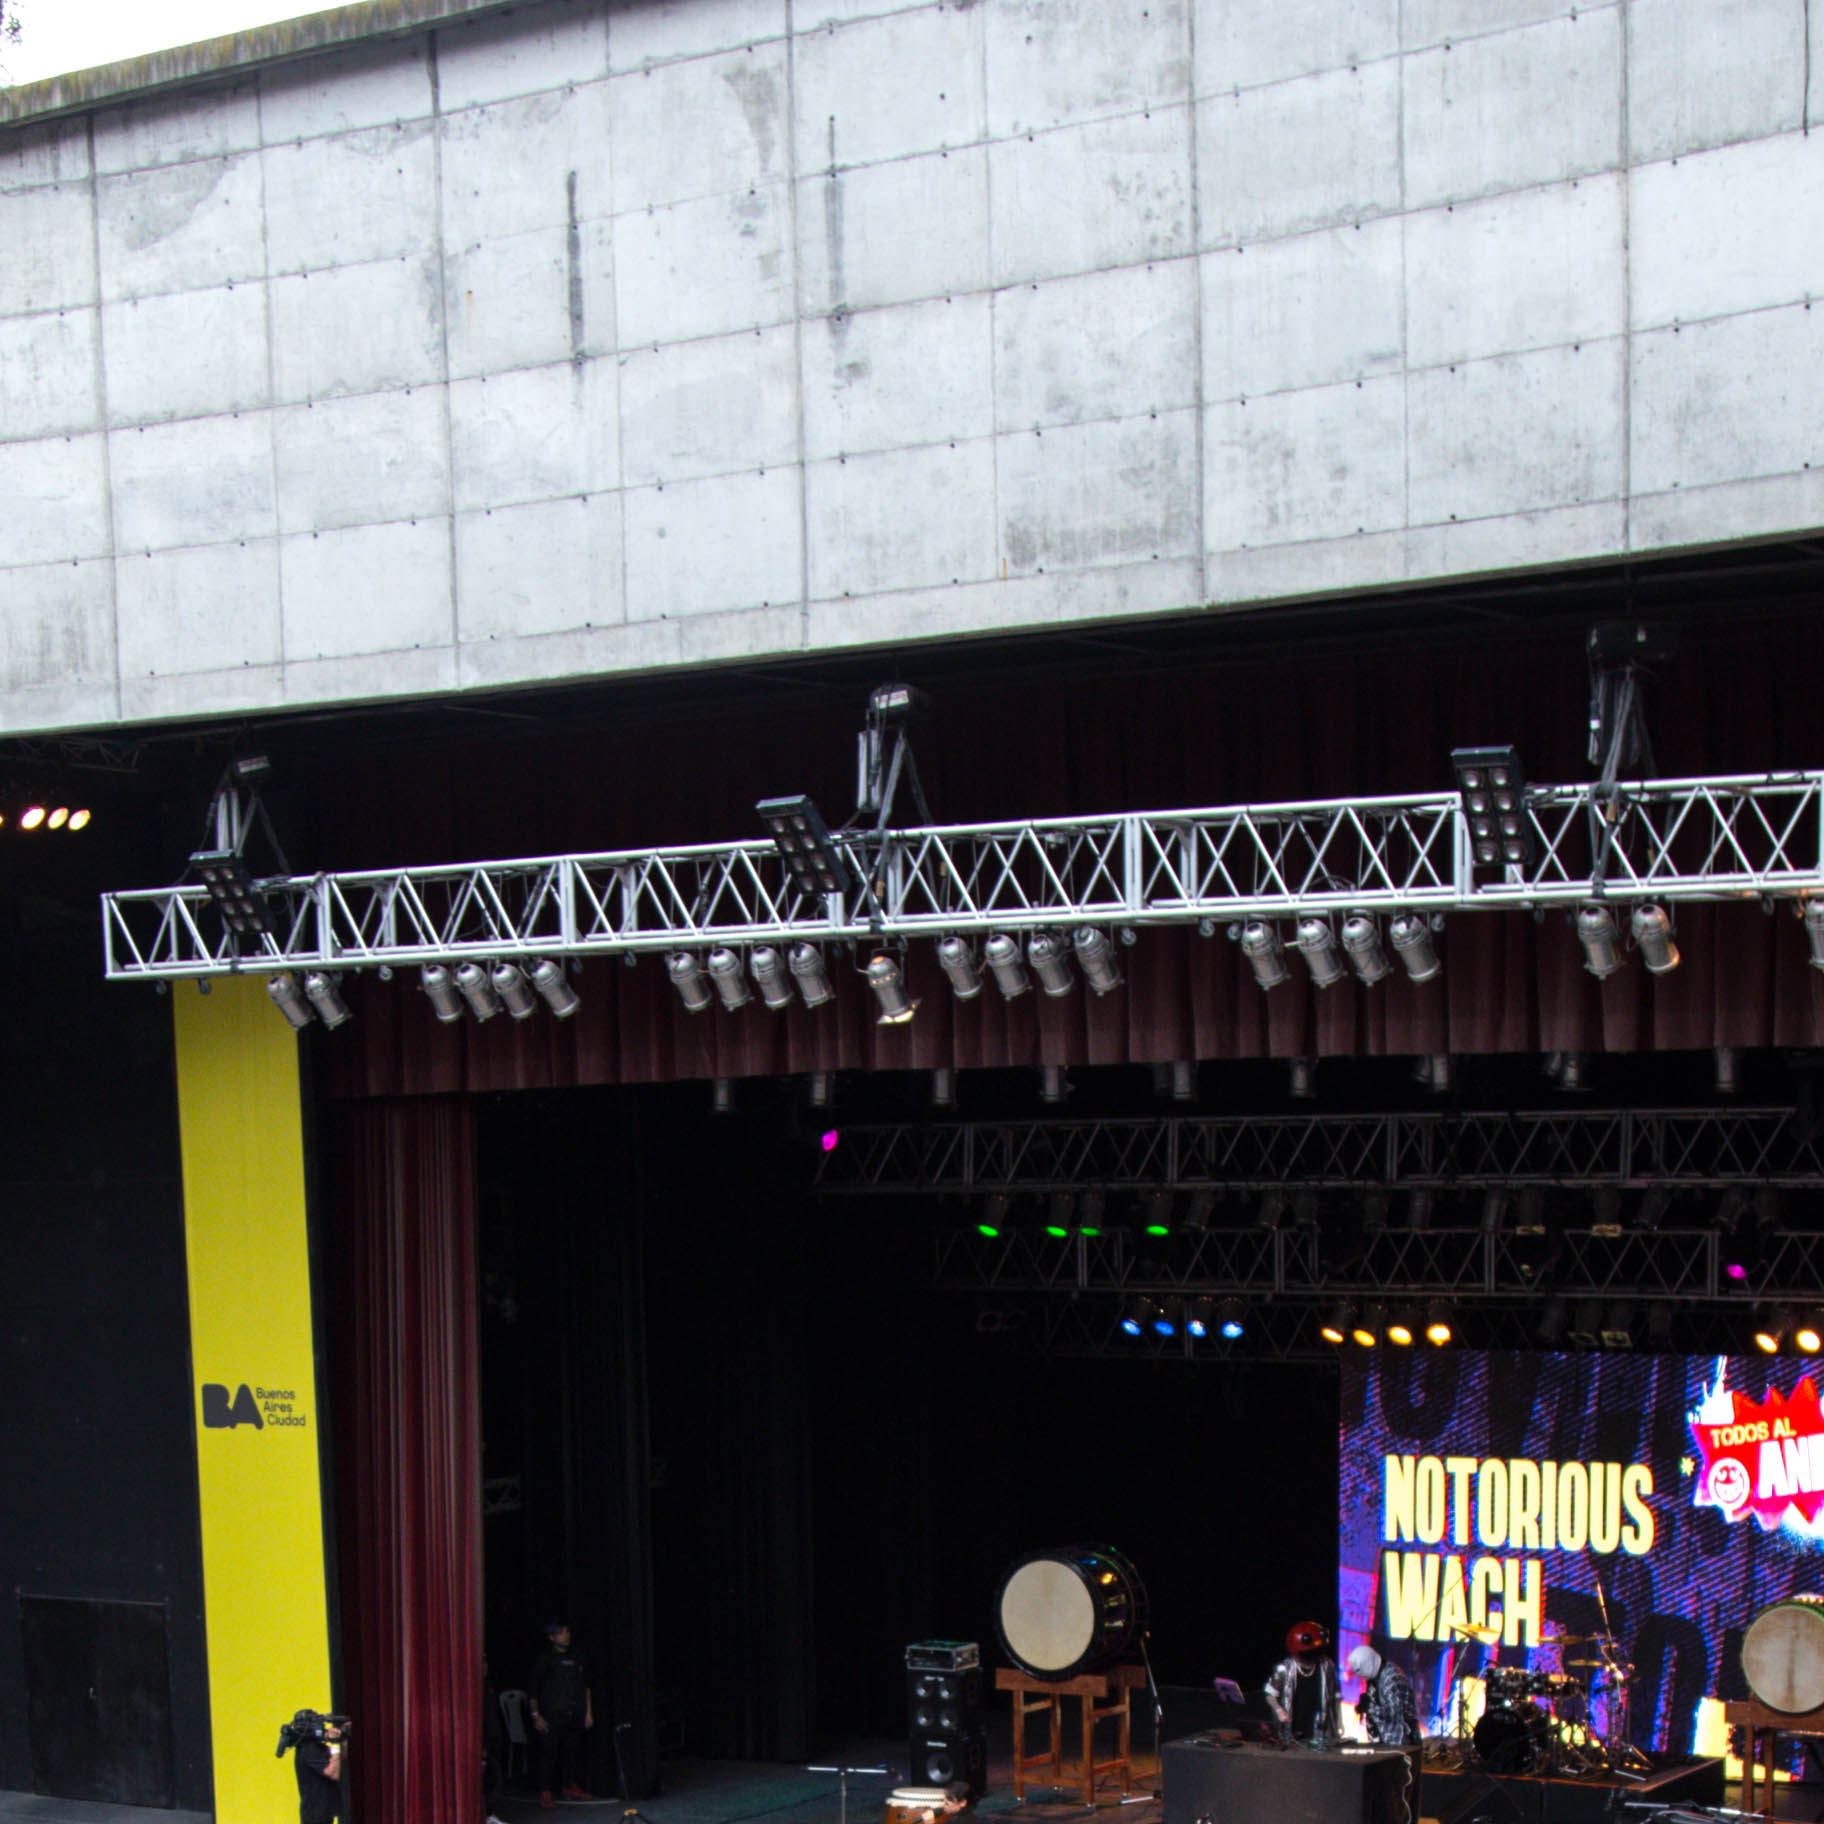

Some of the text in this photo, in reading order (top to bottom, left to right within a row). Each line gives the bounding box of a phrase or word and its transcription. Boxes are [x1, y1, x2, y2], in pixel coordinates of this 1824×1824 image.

[202, 1383, 264, 1430] BA
[256, 1387, 296, 1400] Buenos
[263, 1401, 293, 1413] Aires
[267, 1414, 306, 1427] Ciudad
[1710, 1417, 1796, 1449] TODOS AL
[1385, 1454, 1654, 1555] NOTORIOUS
[1385, 1551, 1543, 1648] WACH
